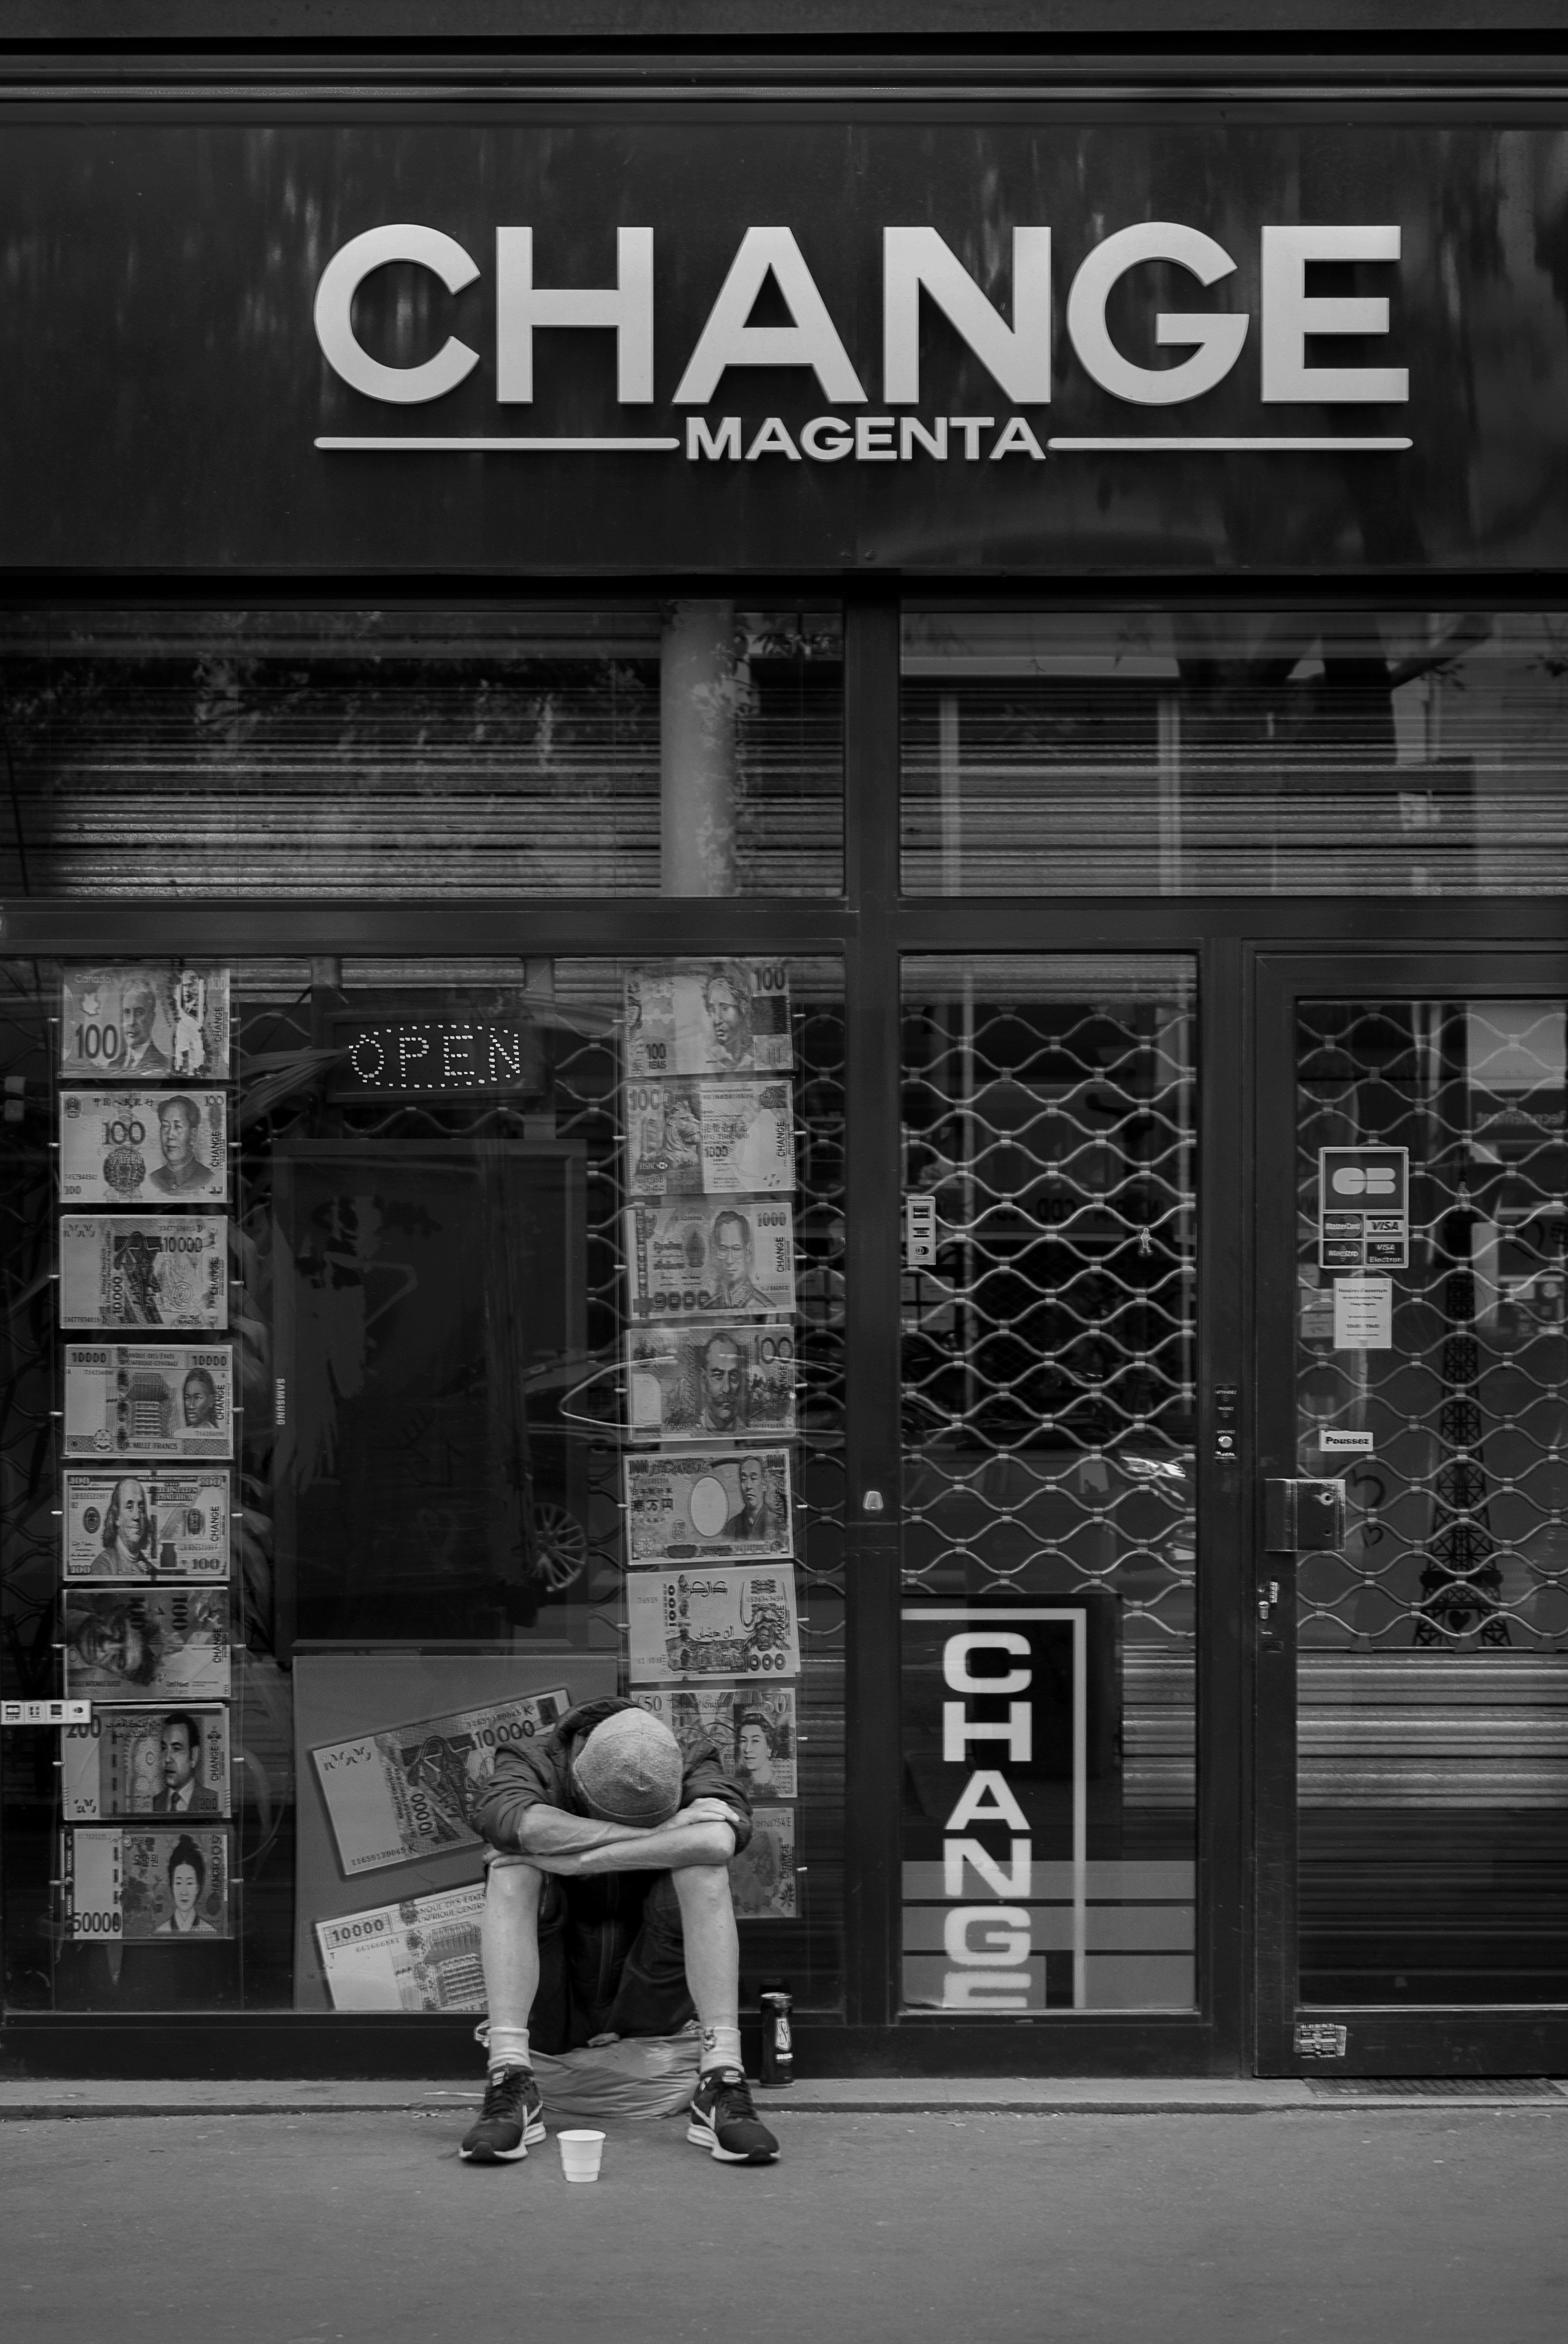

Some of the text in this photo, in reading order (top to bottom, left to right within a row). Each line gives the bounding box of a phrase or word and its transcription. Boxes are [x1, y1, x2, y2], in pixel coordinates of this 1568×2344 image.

[313, 221, 1409, 405] CHANGE
[685, 415, 1047, 462] MAGENTA
[75, 974, 111, 984] Canada
[754, 967, 786, 991] 100
[214, 1006, 222, 1042] CHANGE
[76, 1023, 118, 1059] 100
[646, 1043, 667, 1060] 100
[352, 1033, 520, 1079] OPEN
[648, 1061, 666, 1069] REAIS
[205, 1095, 225, 1107] 100
[629, 1089, 675, 1111] 1000
[102, 1121, 146, 1145] 100
[776, 1121, 785, 1157] CHANGE
[211, 1131, 220, 1167] CHANGE
[704, 1145, 728, 1158] 1000
[63, 1186, 82, 1194] 100
[757, 1212, 787, 1227] 1000
[1371, 1221, 1399, 1231] VISA
[776, 1237, 785, 1272] CHANGE
[211, 1257, 219, 1295] CHANGE
[72, 1352, 107, 1363] 10000
[193, 1355, 227, 1366] 10000
[755, 1335, 792, 1365] 100
[215, 1384, 225, 1420] CHANGE
[275, 1378, 285, 1425] SAMSUNG
[1326, 1436, 1370, 1445] Poussez
[69, 1476, 91, 1485] 100
[200, 1477, 222, 1487] 100
[775, 1489, 784, 1524] CHANGE
[210, 1506, 219, 1541] CHANGE
[69, 1565, 91, 1574] 100
[193, 1558, 220, 1570] 100
[130, 1597, 146, 1630] 100
[172, 1597, 189, 1630] 100
[213, 1628, 222, 1663] CHANGE
[523, 1705, 533, 1716] K
[211, 1746, 219, 1781] CHANGE
[199, 1797, 218, 1810] 200
[386, 1766, 404, 1819] BANQUE CENTRALE
[943, 1632, 1032, 2008] CHANGE
[408, 1843, 417, 1853] K
[780, 1844, 789, 1879] CHANGE
[73, 1912, 122, 1932] 50000
[332, 1919, 385, 1942] 10000
